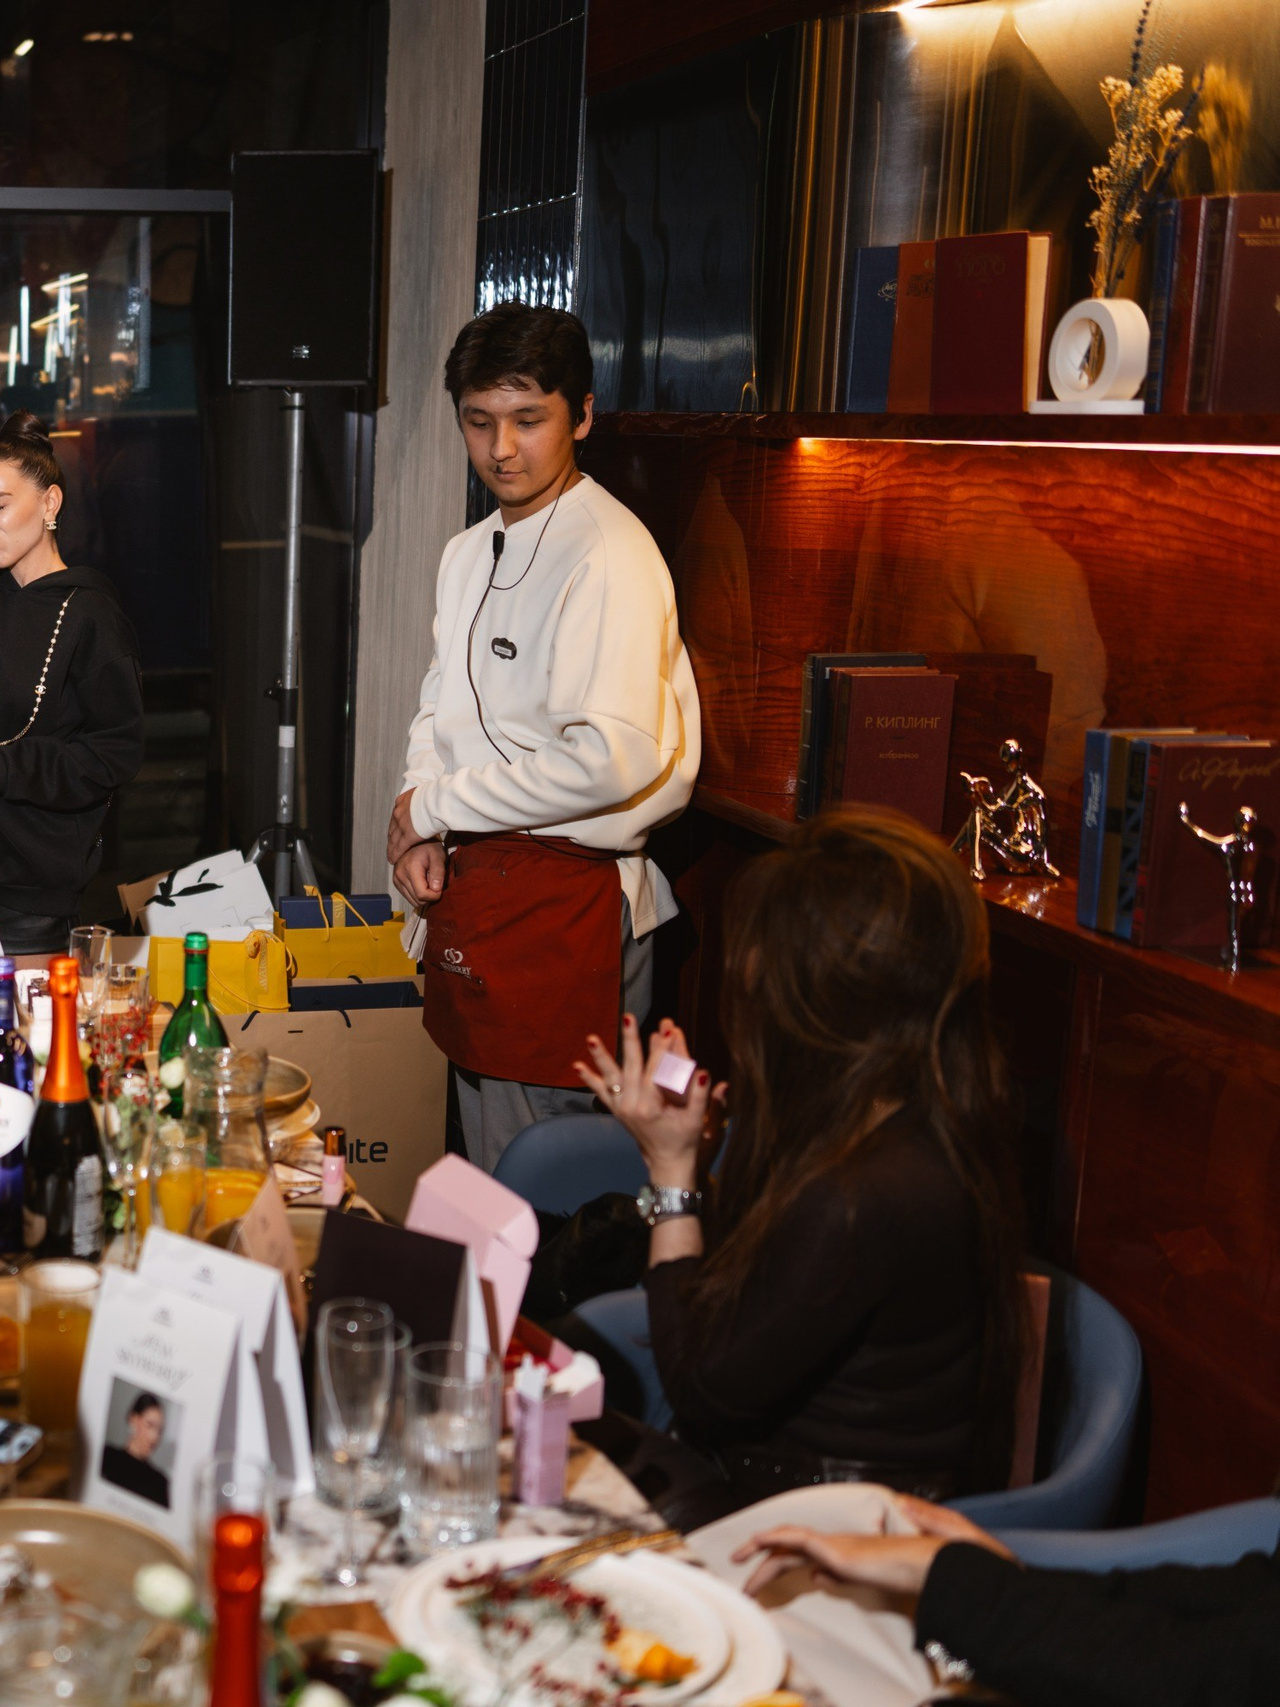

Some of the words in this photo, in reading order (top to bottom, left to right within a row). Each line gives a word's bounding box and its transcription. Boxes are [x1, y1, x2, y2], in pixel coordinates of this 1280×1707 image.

[865, 716, 873, 729] Р.
[876, 716, 941, 729] КИПЛИНГ
[879, 750, 919, 760] избранное
